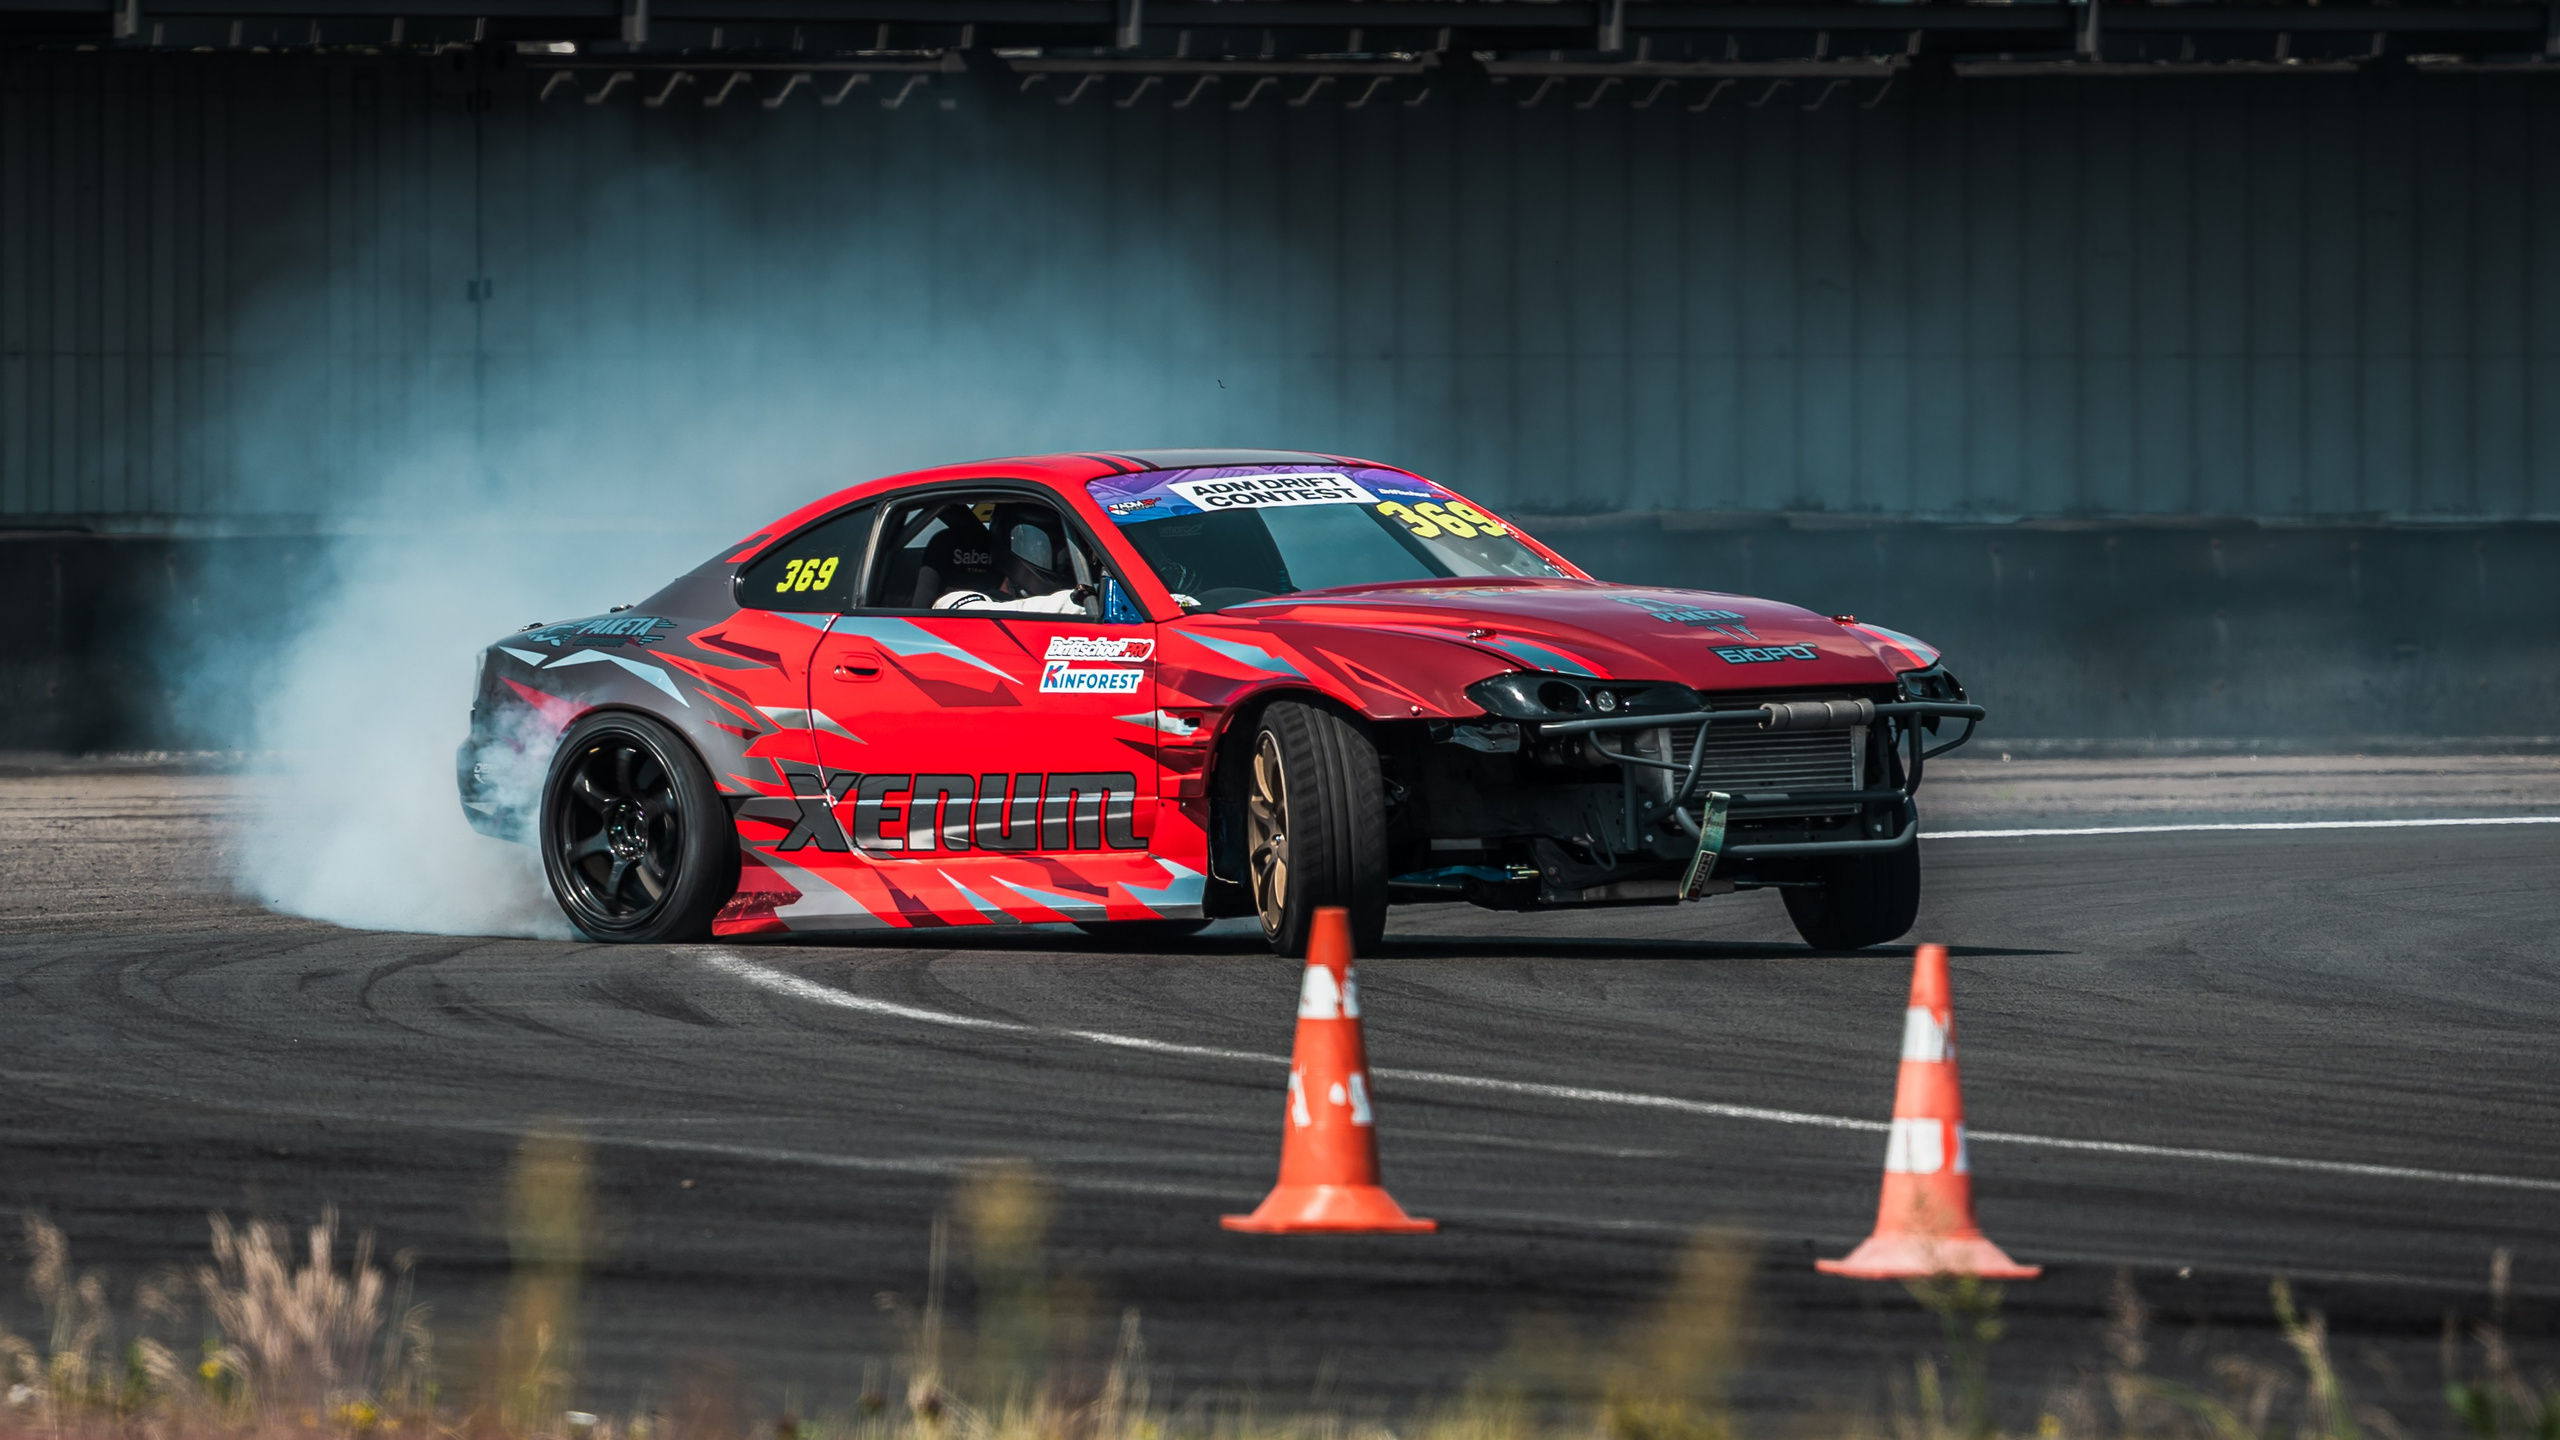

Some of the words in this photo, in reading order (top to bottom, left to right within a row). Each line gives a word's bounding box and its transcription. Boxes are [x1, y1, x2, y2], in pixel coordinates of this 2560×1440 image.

[1192, 480, 1261, 496] ADM
[1257, 477, 1341, 490] DRIFT
[1204, 487, 1358, 507] CONTEST
[1375, 500, 1509, 539] 369
[776, 556, 839, 592] 369
[1715, 646, 1817, 664] БЮРО
[1043, 665, 1140, 689] KINFOREST
[775, 771, 1150, 852] XENUM
